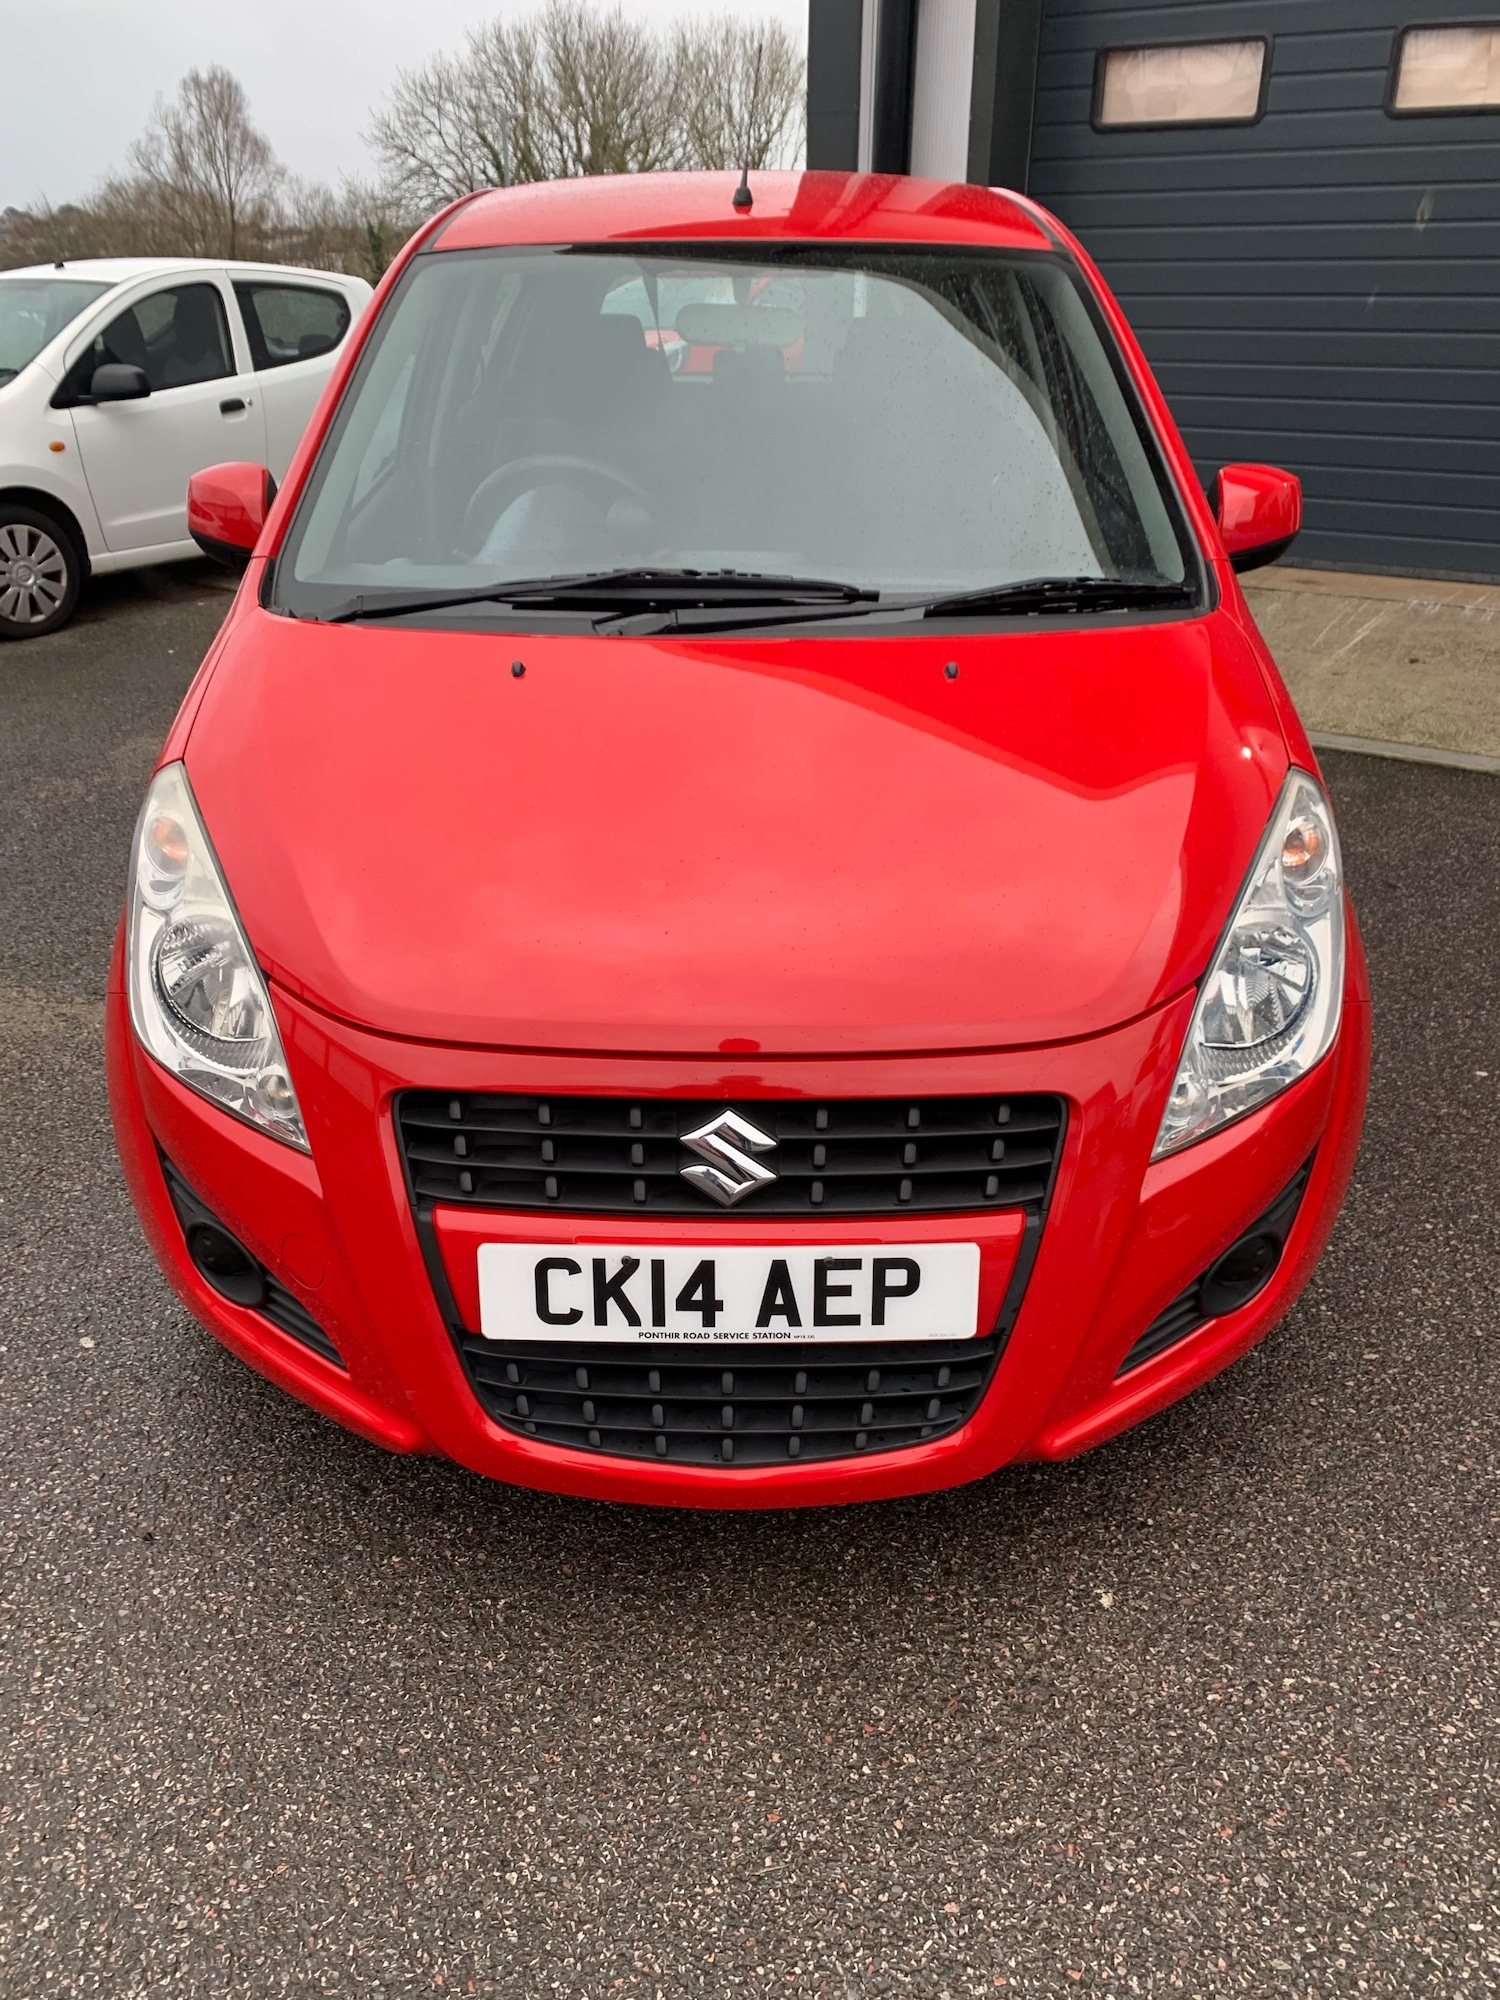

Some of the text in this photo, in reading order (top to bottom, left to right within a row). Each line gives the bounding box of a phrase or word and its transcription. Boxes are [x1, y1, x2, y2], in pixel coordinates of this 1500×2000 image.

[535, 1257, 921, 1327] CK14 AEP
[638, 1332, 680, 1340] PONTHIR
[683, 1332, 711, 1340] ROAD
[713, 1332, 750, 1340] SERVICE
[752, 1332, 791, 1340] STATION
